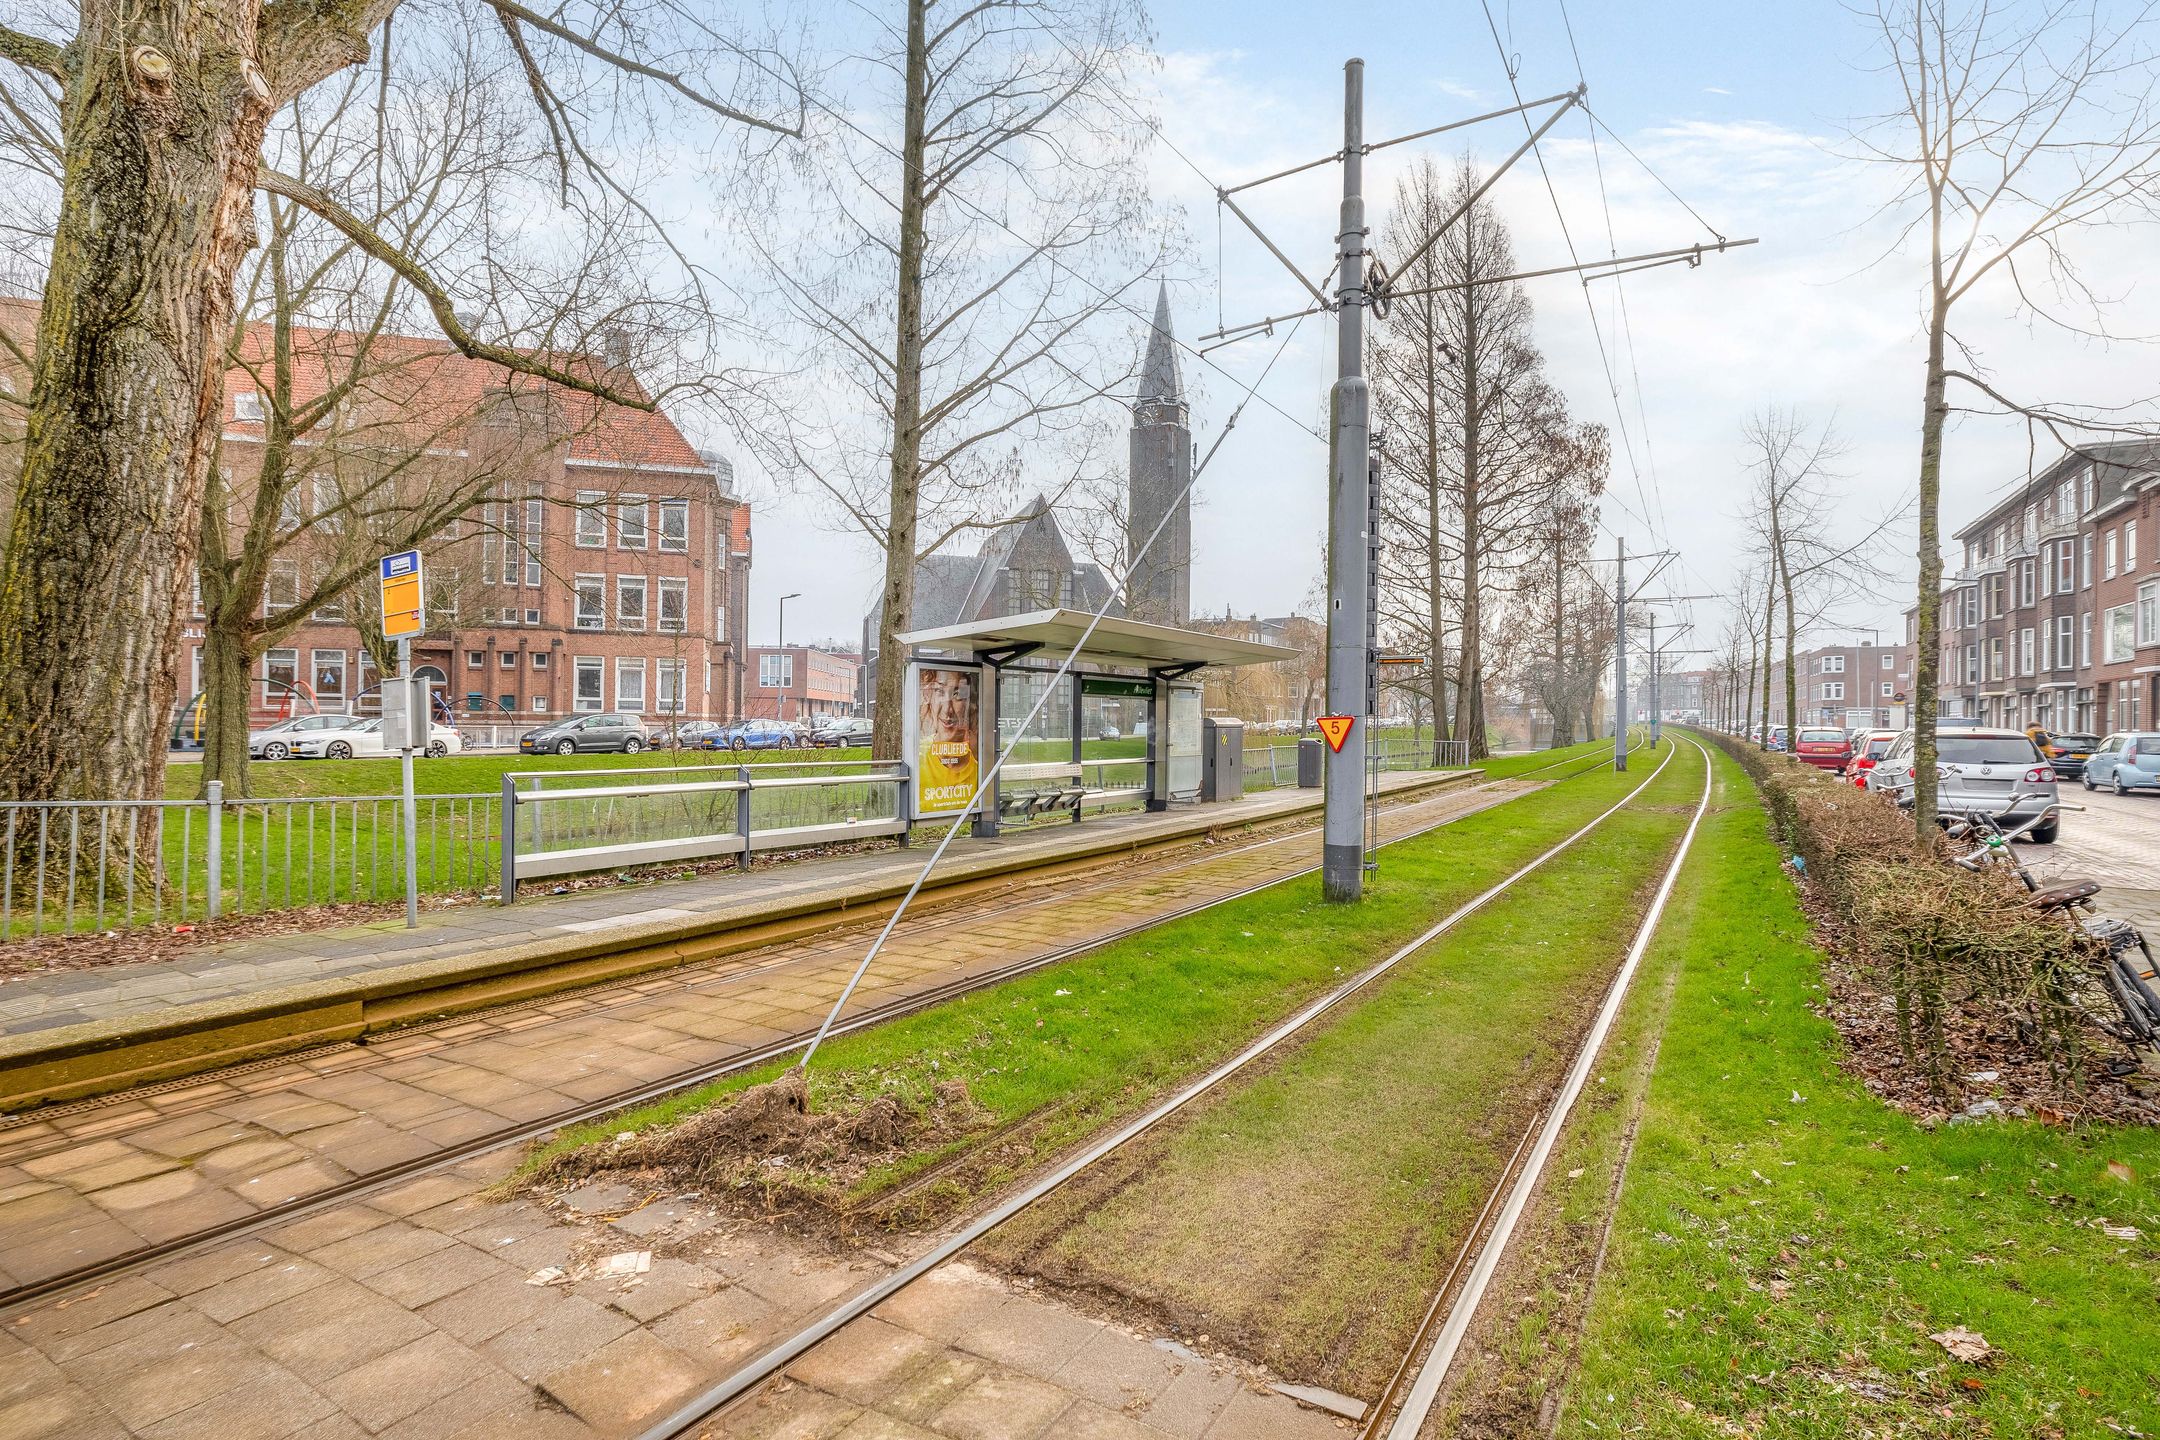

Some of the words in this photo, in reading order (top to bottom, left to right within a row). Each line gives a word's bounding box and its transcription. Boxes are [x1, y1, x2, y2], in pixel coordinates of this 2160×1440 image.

[1331, 721, 1340, 735] 5
[931, 743, 968, 755] CLUBLIEFDE
[925, 783, 973, 801] SPORTCITY
